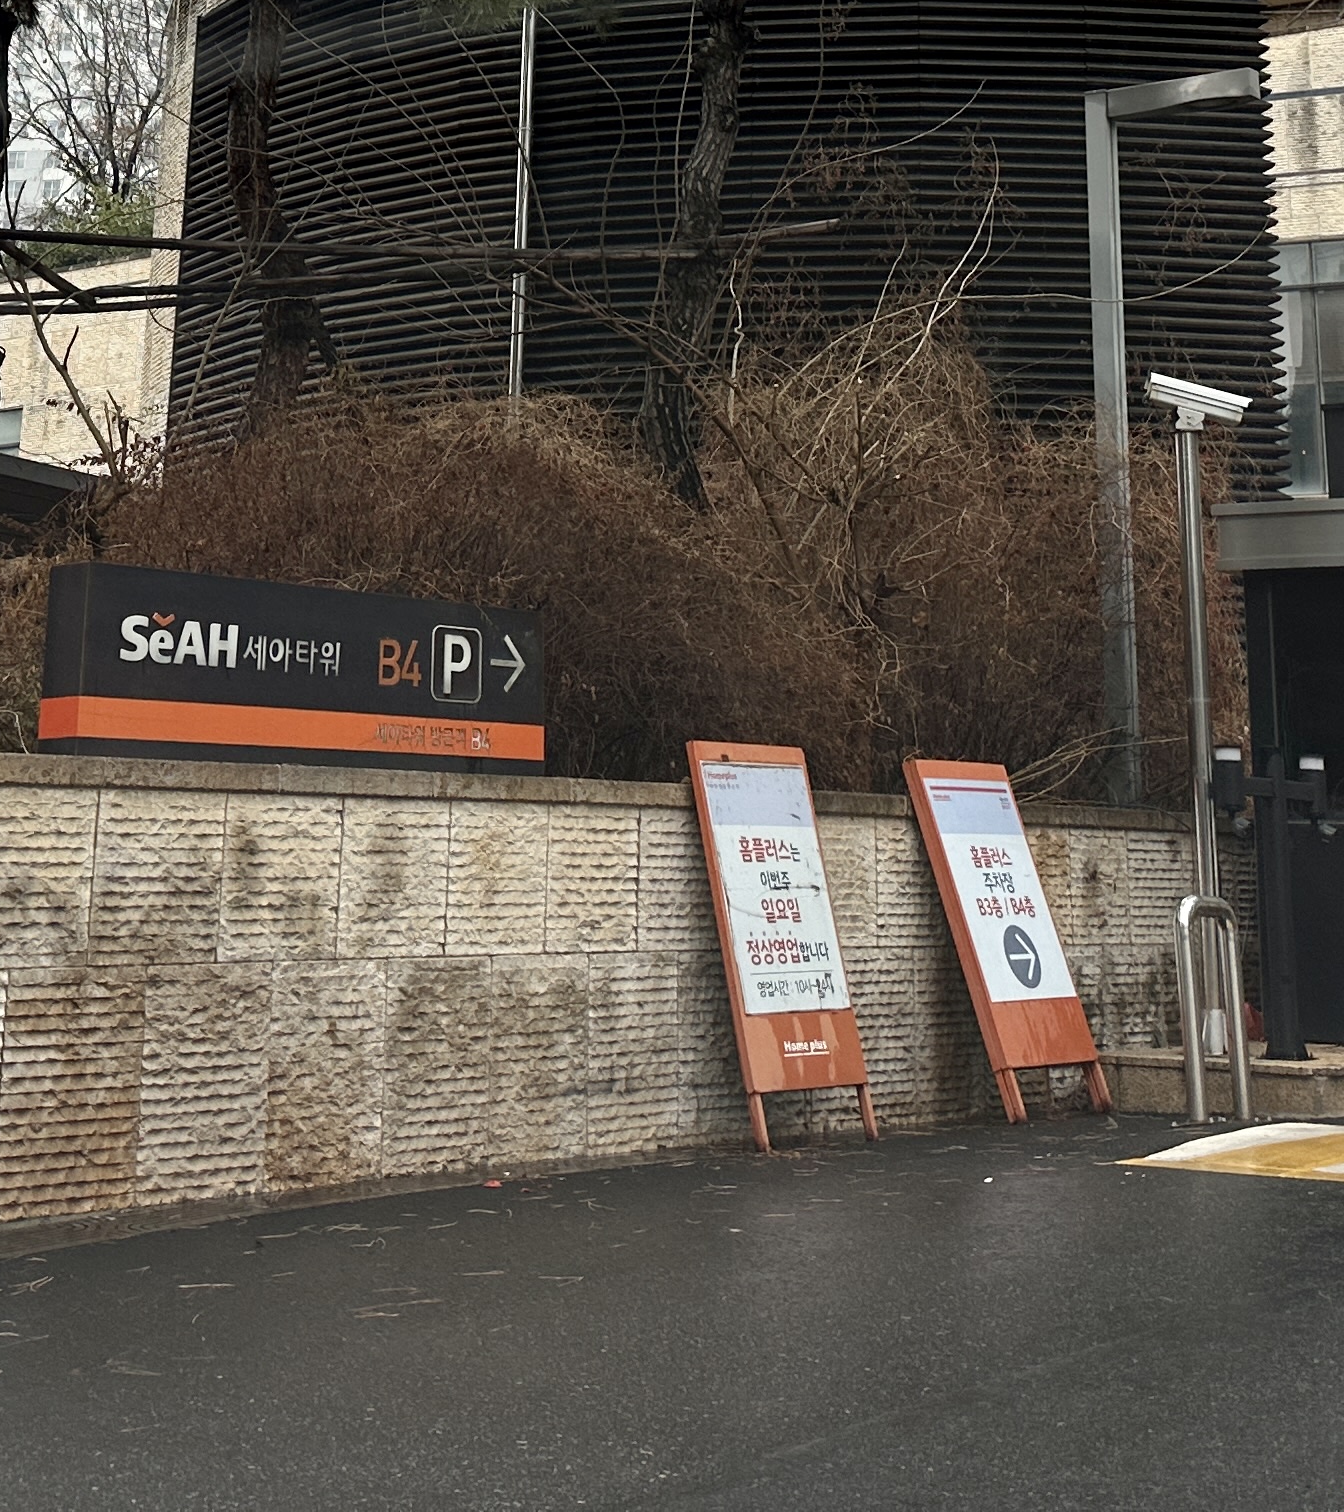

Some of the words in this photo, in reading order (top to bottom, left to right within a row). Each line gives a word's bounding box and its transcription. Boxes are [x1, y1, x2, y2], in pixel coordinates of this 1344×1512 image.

[243, 635, 342, 677] 세아타워
[377, 637, 422, 688] B4
[471, 727, 492, 751] B4
[739, 836, 801, 862] 홈플러스는
[970, 845, 1013, 868] 홈플러스
[760, 871, 791, 890] 이번주
[982, 872, 1015, 893] 주차장
[761, 898, 802, 923] 일요일
[976, 896, 1003, 918] B3층
[1010, 896, 1036, 918] B4층
[746, 938, 830, 966] 정상영업합니다
[757, 980, 790, 997] 영업시간
